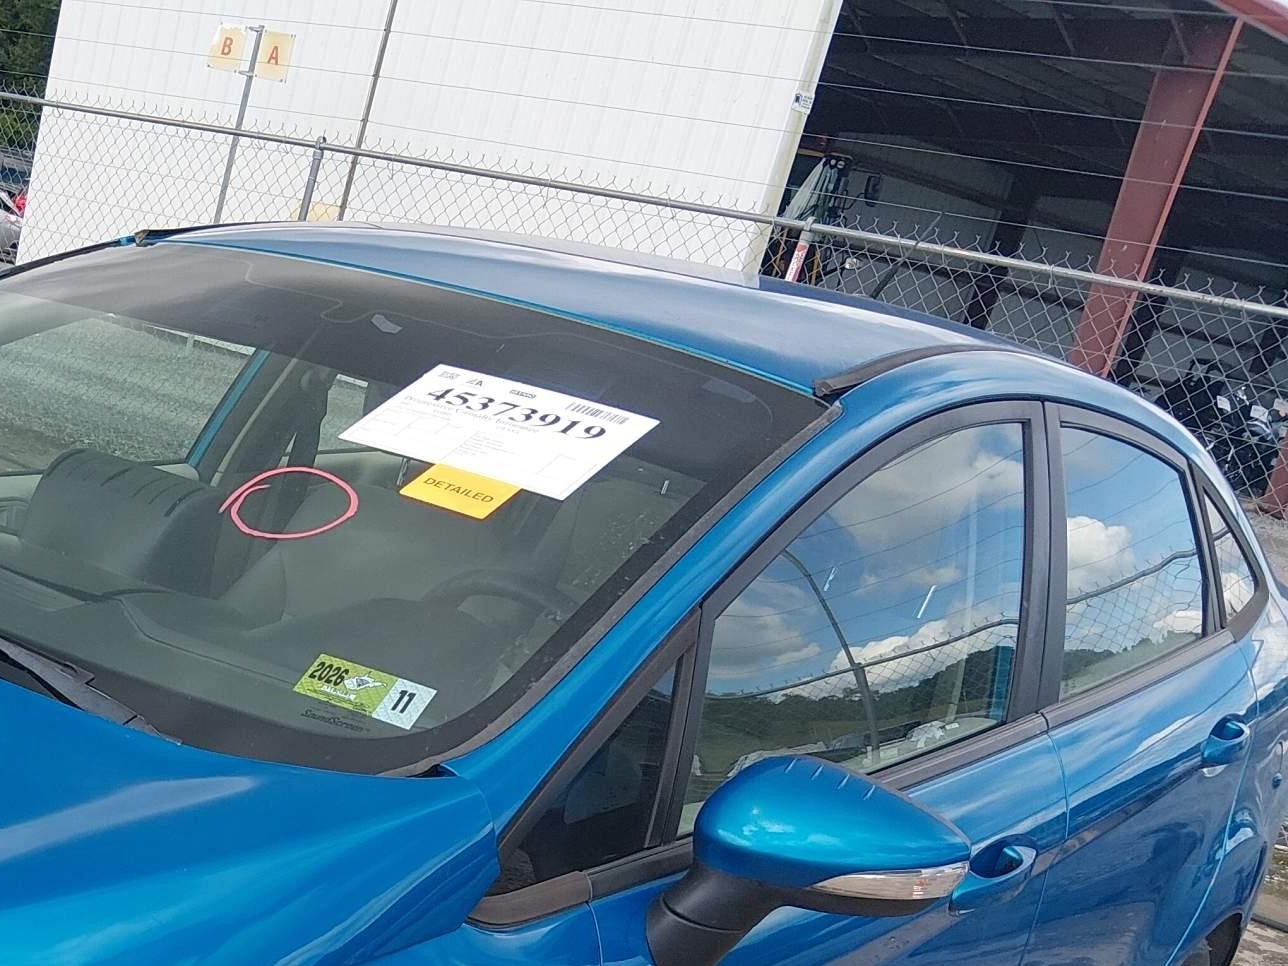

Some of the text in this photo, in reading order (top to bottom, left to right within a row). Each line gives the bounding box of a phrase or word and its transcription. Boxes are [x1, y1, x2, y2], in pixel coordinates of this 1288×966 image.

[220, 36, 233, 56] B
[267, 45, 280, 66] A
[427, 387, 607, 440] 45373919
[423, 476, 495, 504] DETAILED
[308, 661, 417, 714] 2026 11
